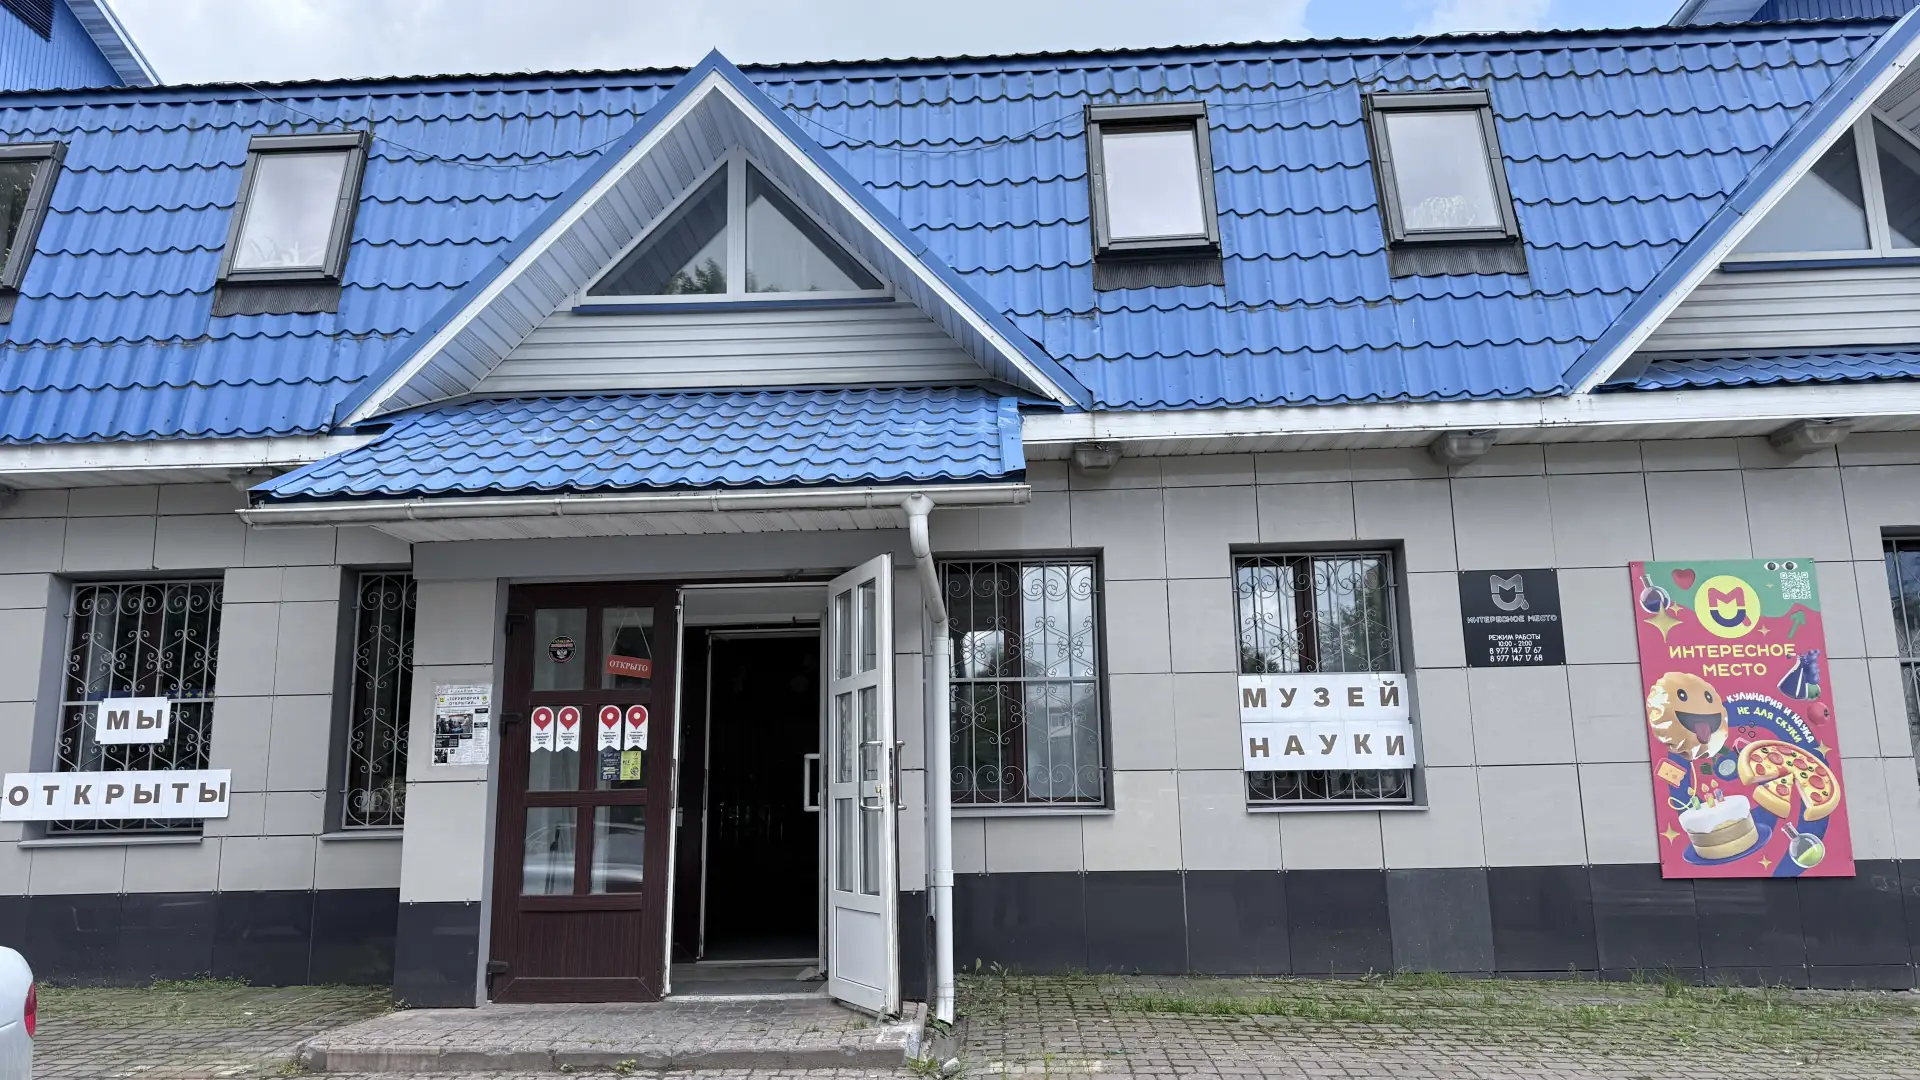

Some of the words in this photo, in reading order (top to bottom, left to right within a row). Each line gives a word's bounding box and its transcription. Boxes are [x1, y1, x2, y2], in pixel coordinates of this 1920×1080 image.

[1467, 615, 1525, 623] ИНТЕРЕСНОЕ
[1528, 614, 1557, 622] МЕСТО
[1489, 647, 1494, 655] 8
[1511, 646, 1522, 654] 147
[1511, 654, 1523, 662] 147
[1669, 643, 1797, 659] ИНТЕРЕСНОЕ
[609, 659, 648, 672] ОТКРЫТО
[1702, 663, 1767, 677] МЕСТО
[1242, 680, 1400, 708] МУЗЕЙ
[106, 709, 163, 730] МЫ
[1726, 691, 1783, 710] КУЛИНАРИЯ
[1783, 706, 1792, 716] И
[1791, 713, 1815, 743] НАУКА
[1736, 706, 1751, 715] НЕ
[1753, 706, 1774, 720] ДЛЯ
[1775, 716, 1803, 743] СКУКИ
[1250, 733, 1405, 758] НАУКИ
[8, 782, 226, 806] ОТКРЫТЫ
